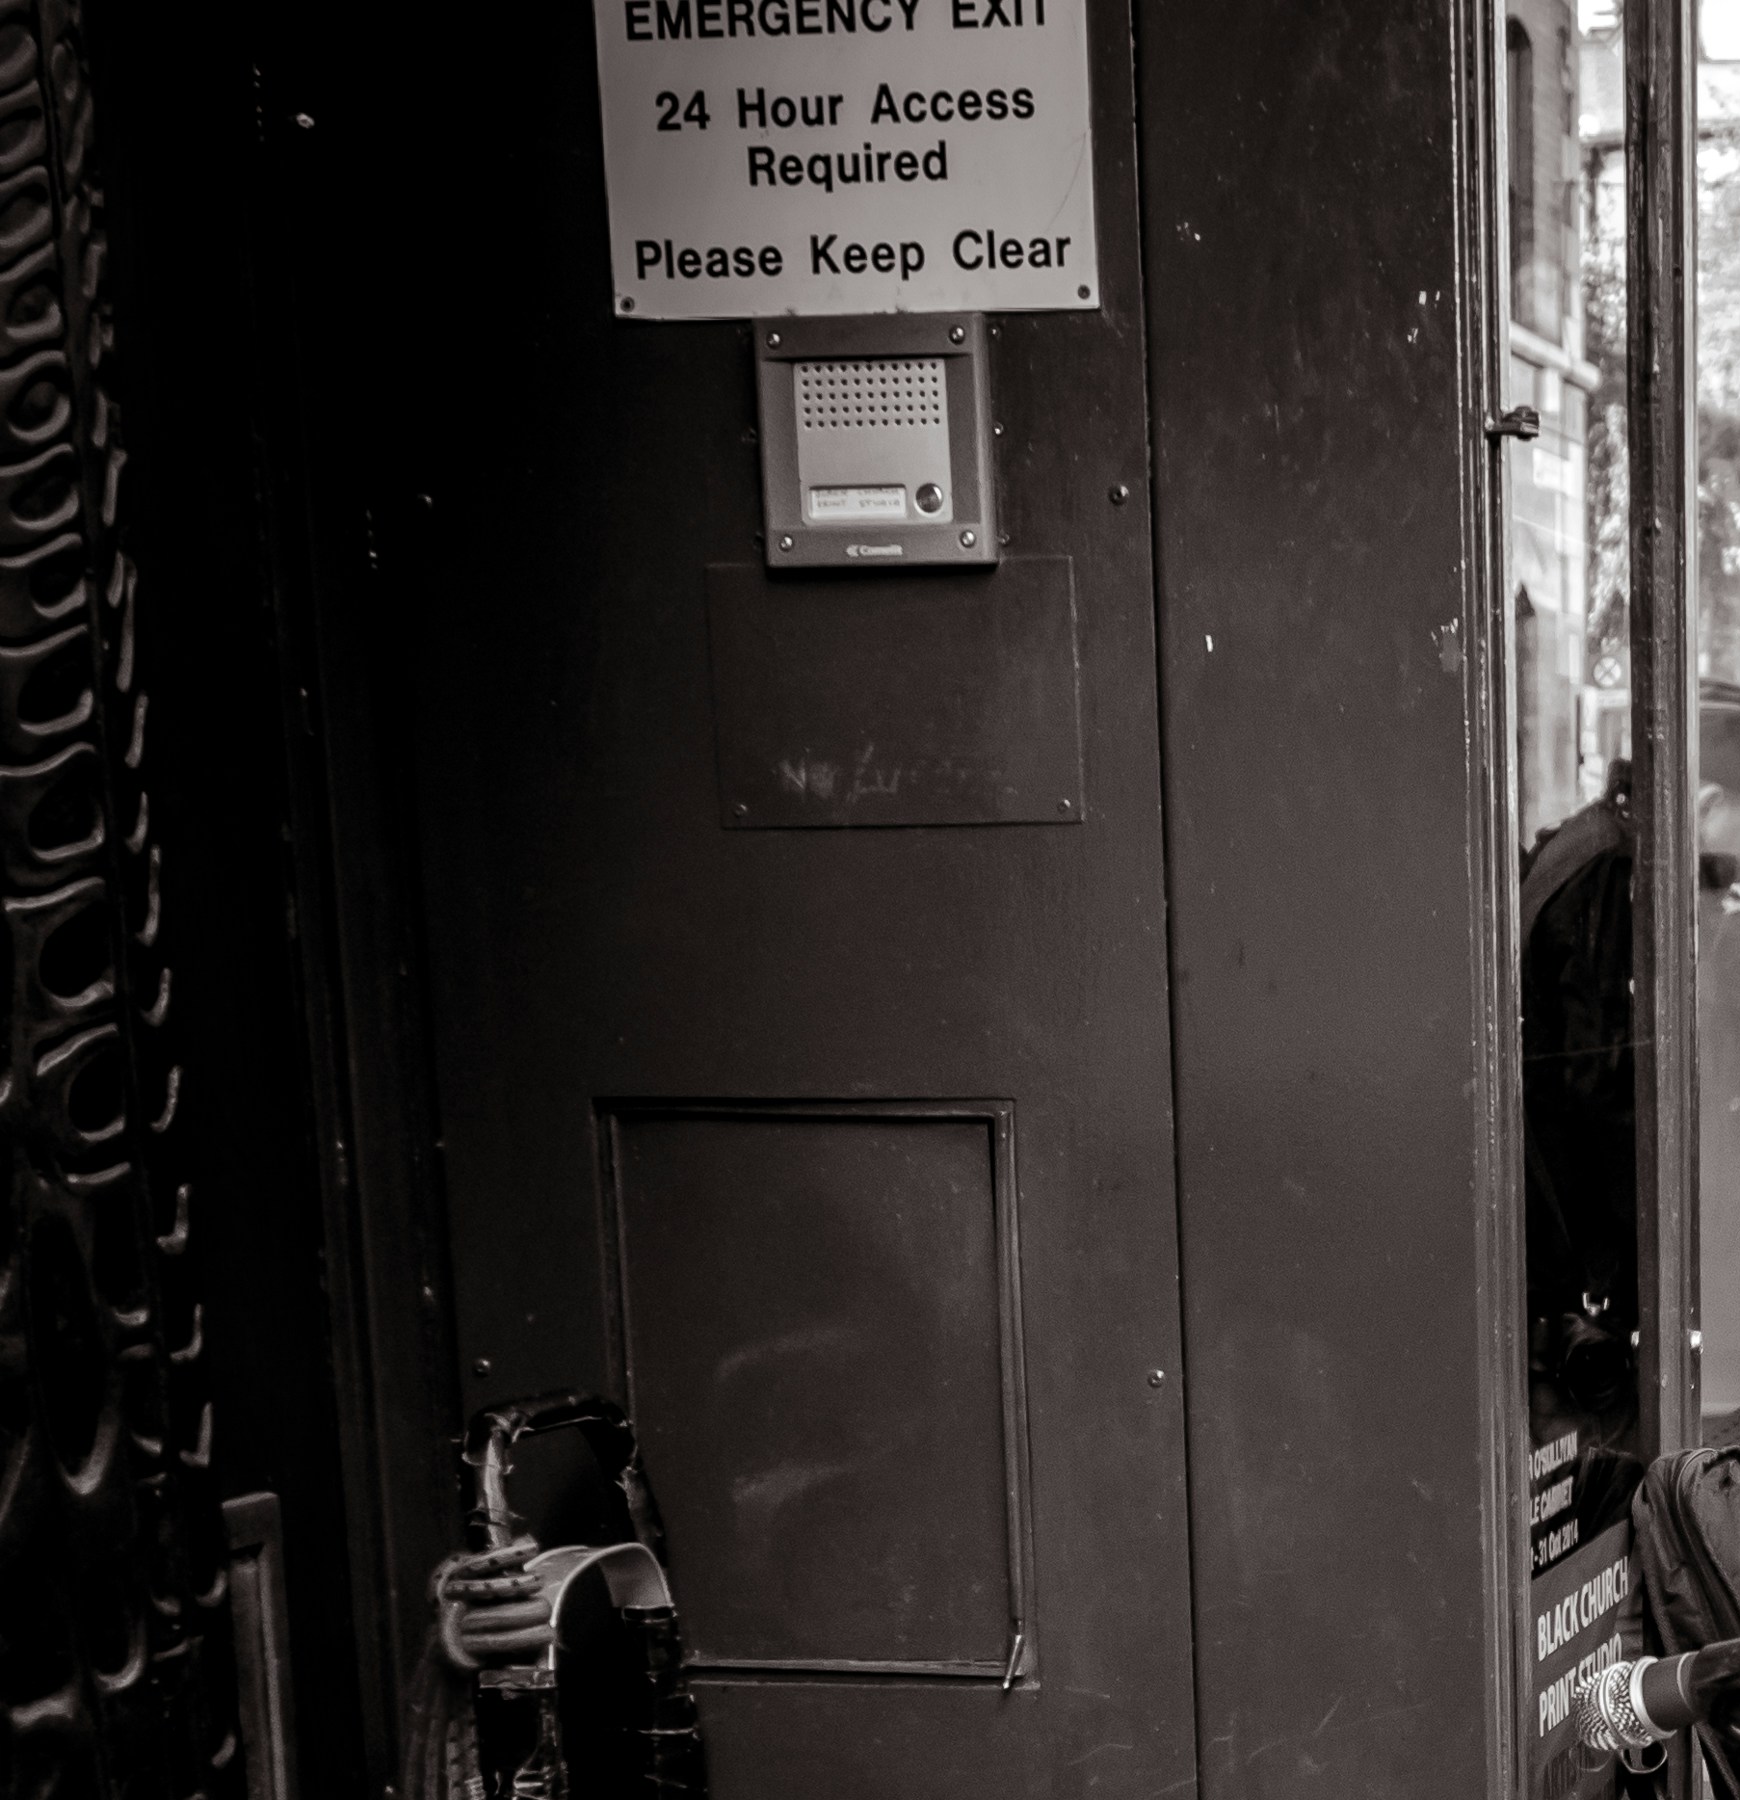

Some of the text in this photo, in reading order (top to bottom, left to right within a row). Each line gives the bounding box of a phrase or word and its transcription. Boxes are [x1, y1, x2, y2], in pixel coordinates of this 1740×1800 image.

[624, 0, 919, 42] EMERGENCY
[655, 83, 1035, 132] 24 Hour Access
[747, 140, 948, 193] Required
[635, 230, 1071, 280] Please Keep Clear
[1538, 1556, 1628, 1661] BLACK CHURCH
[1539, 1666, 1577, 1738] PRINT
